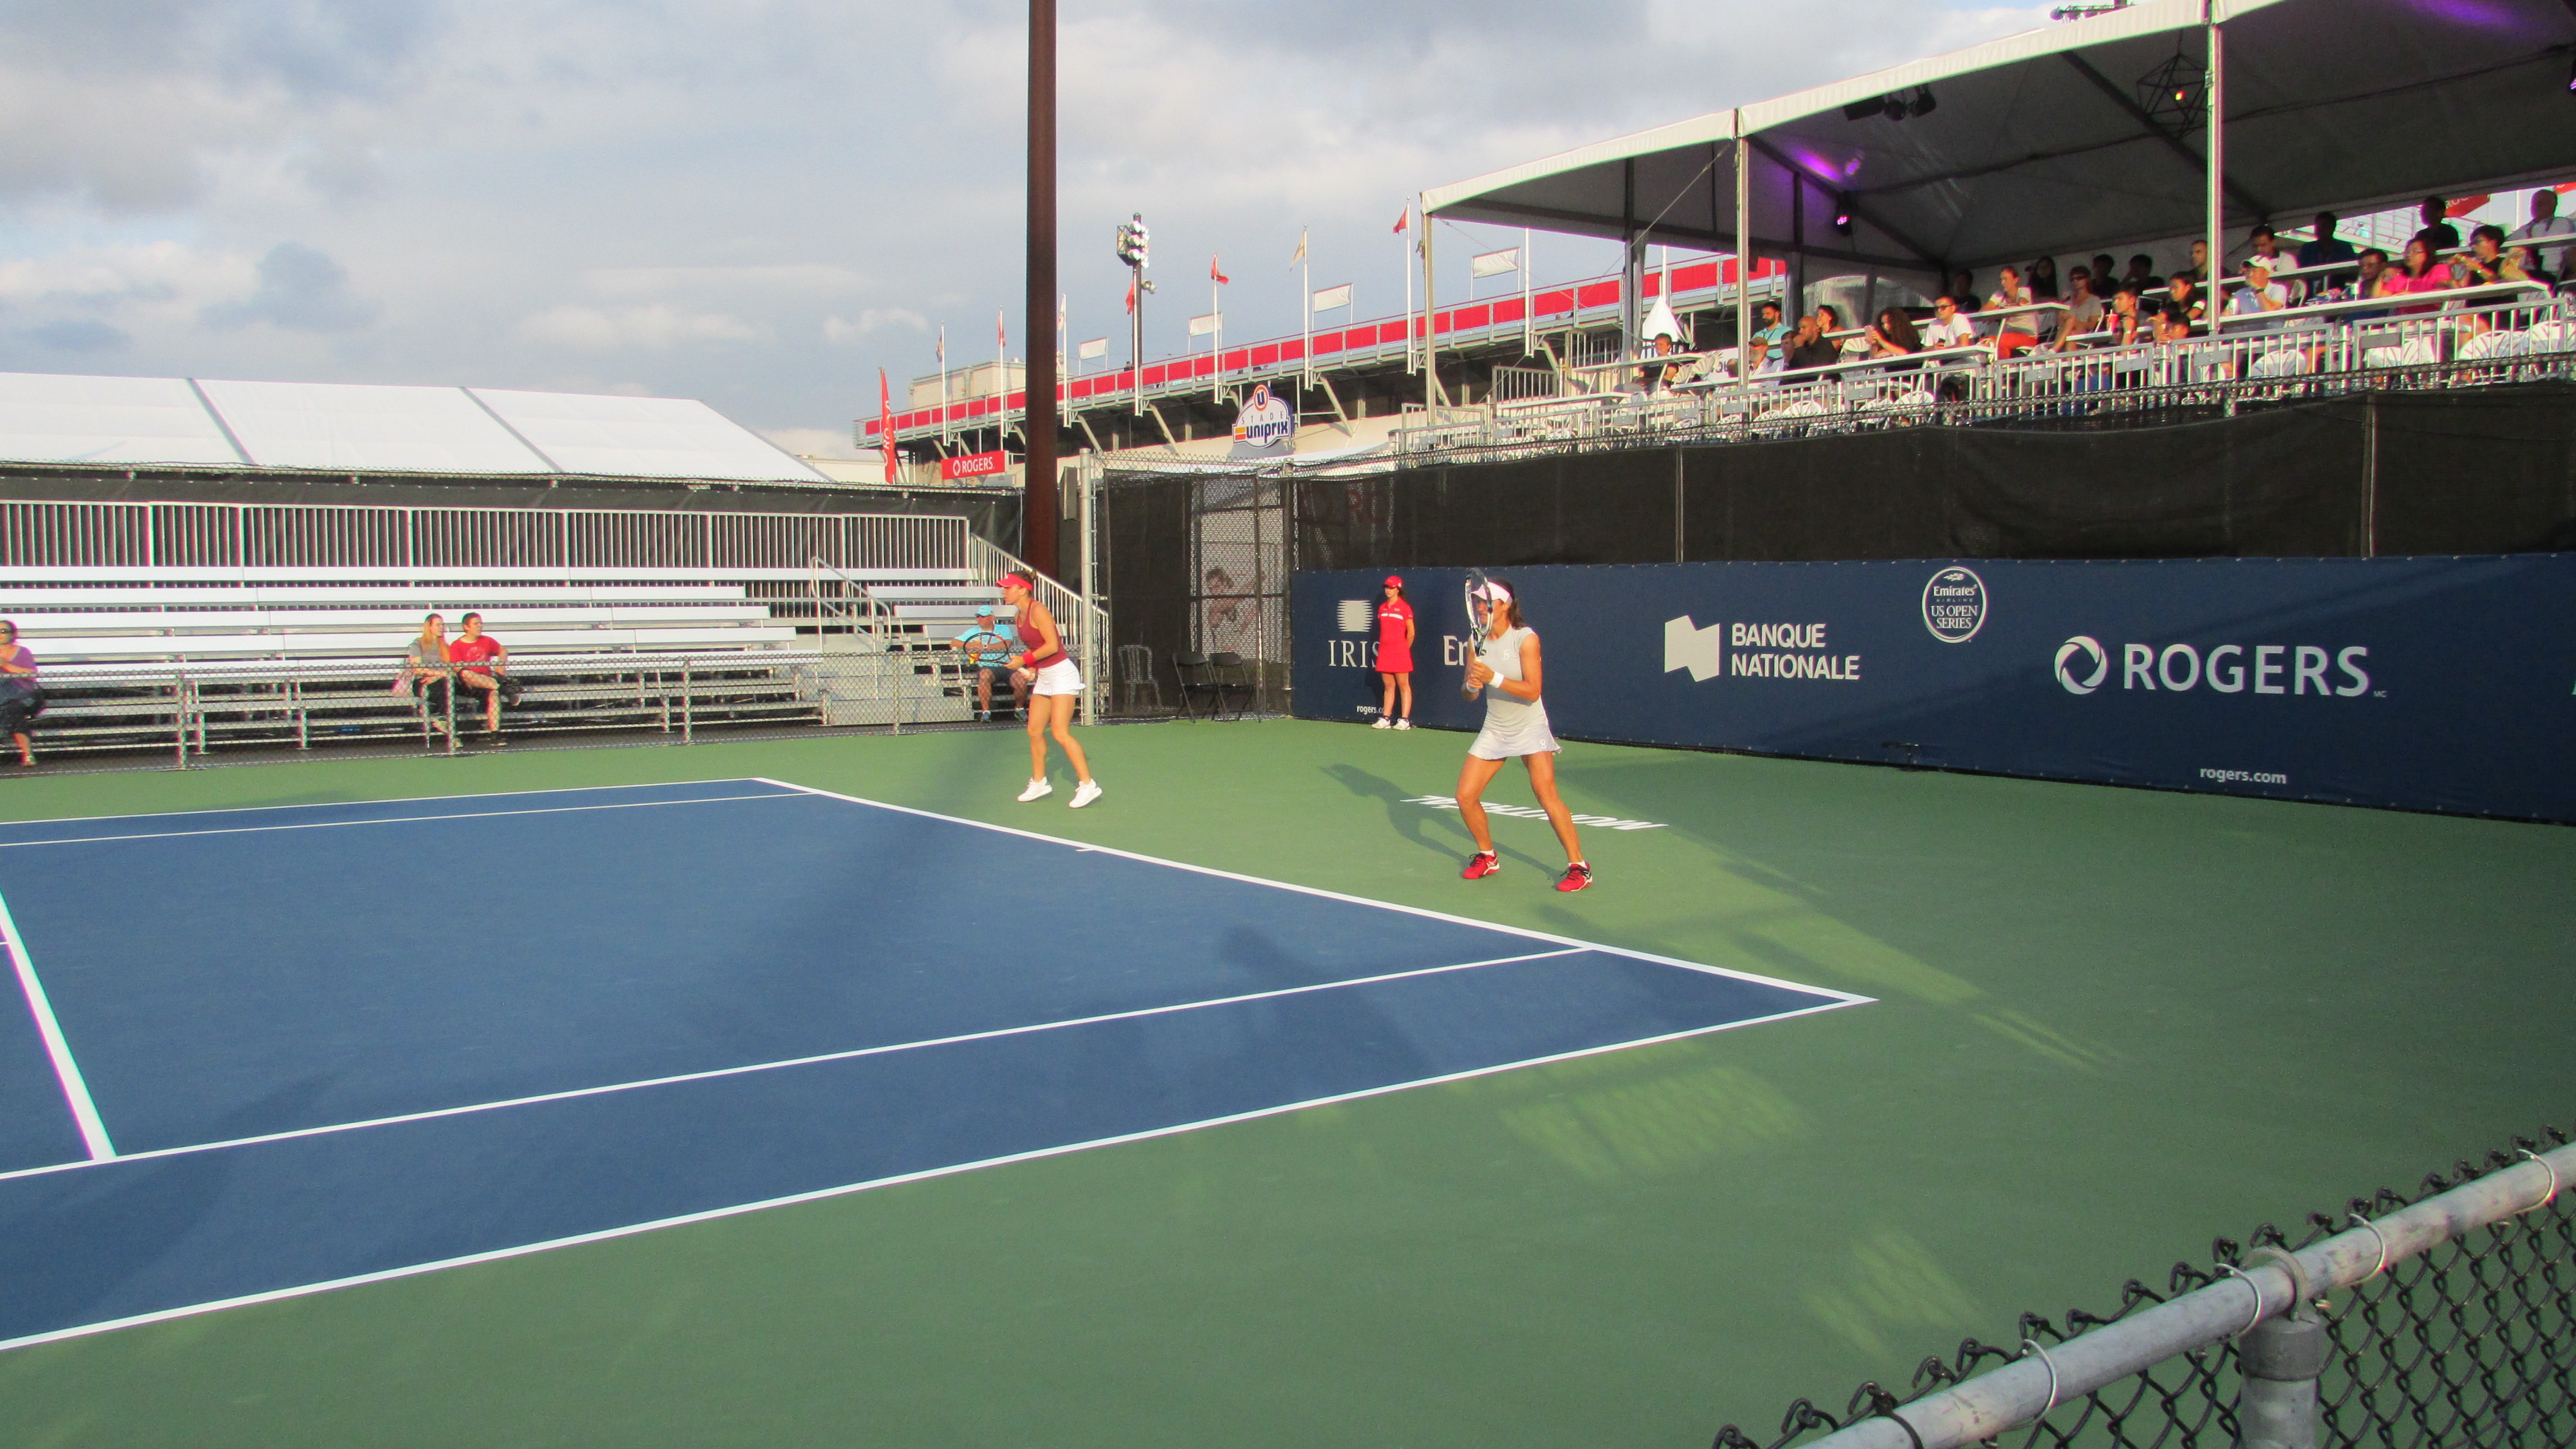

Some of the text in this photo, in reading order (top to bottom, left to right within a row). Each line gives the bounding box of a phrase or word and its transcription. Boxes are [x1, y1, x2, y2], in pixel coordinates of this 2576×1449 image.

[1242, 411, 1283, 425] STADE
[1246, 420, 1288, 444] uniprix
[962, 456, 993, 473] ROGERS
[1933, 585, 1974, 596] Emirates
[1930, 605, 1978, 617] US OPEN
[1936, 617, 1972, 629] SERIES
[1732, 623, 1827, 649] BANQUE
[1731, 652, 1861, 680] NATIONALE
[2124, 643, 2371, 697] ROGERS
[2200, 767, 2287, 784] rogers.com
